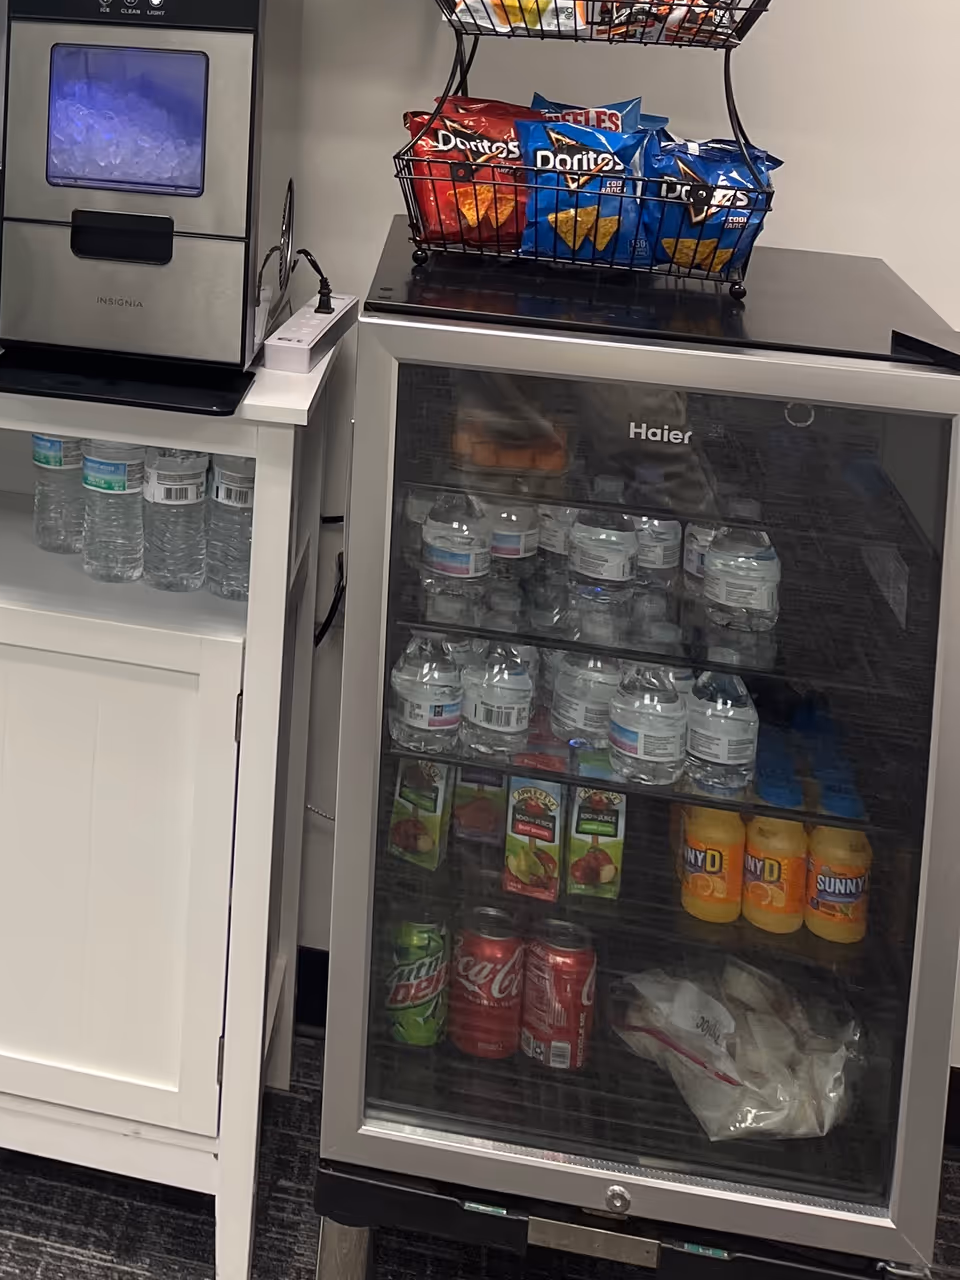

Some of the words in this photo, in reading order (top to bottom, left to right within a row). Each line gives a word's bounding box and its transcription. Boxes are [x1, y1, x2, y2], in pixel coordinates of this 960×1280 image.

[437, 130, 521, 159] Doritos
[536, 150, 625, 171] Doritos
[96, 296, 144, 308] INSIGNIA
[629, 422, 693, 444] Haier
